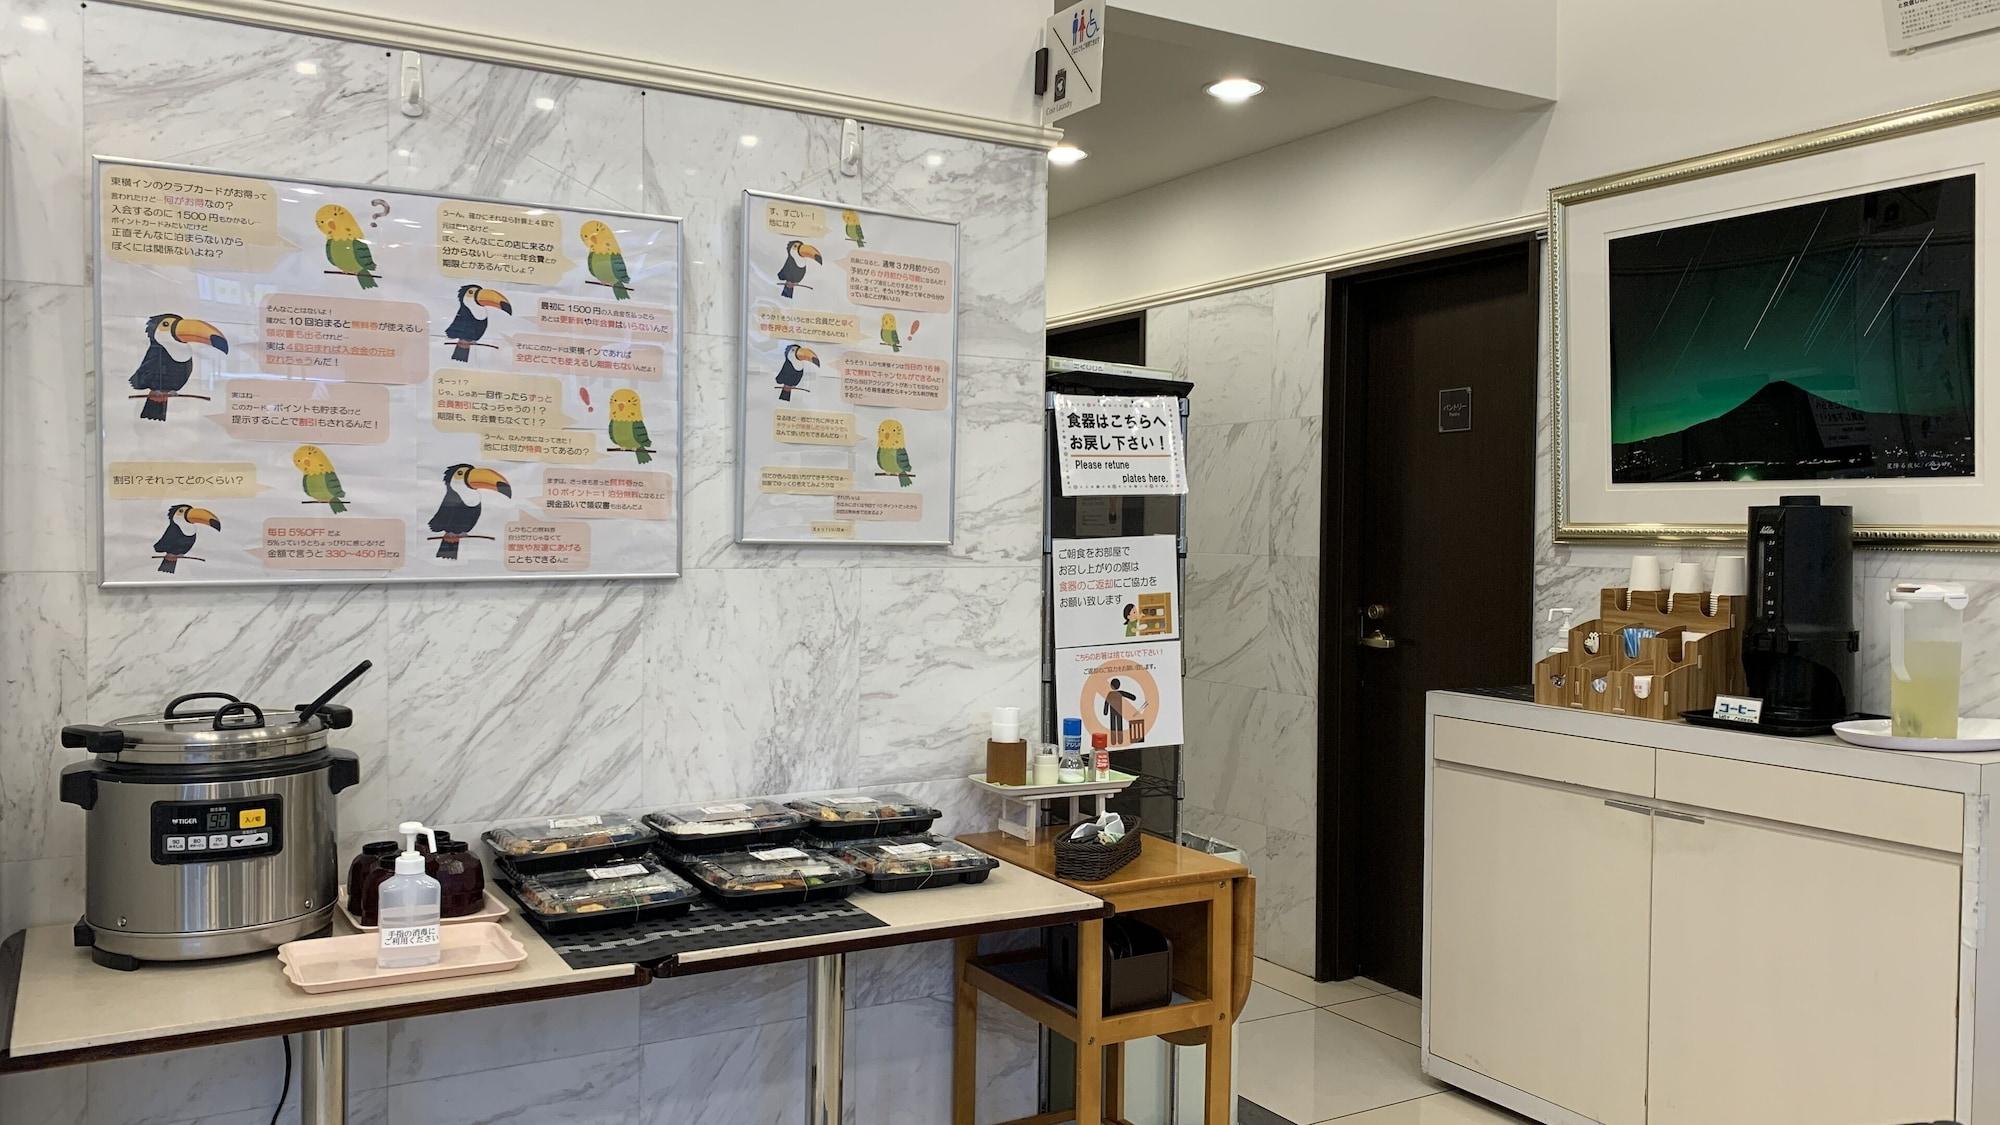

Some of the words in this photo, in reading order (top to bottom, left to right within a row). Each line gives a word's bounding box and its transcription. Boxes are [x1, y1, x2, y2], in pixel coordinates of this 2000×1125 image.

[111, 228, 244, 247] 正直そんなに泊まらないから
[111, 242, 224, 259] ぼくには関係ないよね？
[266, 305, 332, 316] そんなことはないよ！
[1067, 412, 1166, 429] 食器はこちらへ
[1070, 435, 1164, 451] お戻し下さい！
[1075, 460, 1102, 470] Please
[1105, 460, 1130, 470] retune
[113, 475, 244, 486] 割引？それってどのくらい？
[1122, 473, 1146, 483] plates
[1149, 473, 1169, 483] here.
[1058, 546, 1130, 560] ご朝食をお部屋で
[1058, 561, 1139, 576] お召し上がりの際は
[1059, 576, 1158, 593] 食器のご返却にご協力を
[1060, 594, 1123, 608] お願い致します
[1719, 703, 1756, 714] コーヒー
[384, 935, 438, 946] ご利用ください
[388, 928, 436, 939] 手指の消毒に
